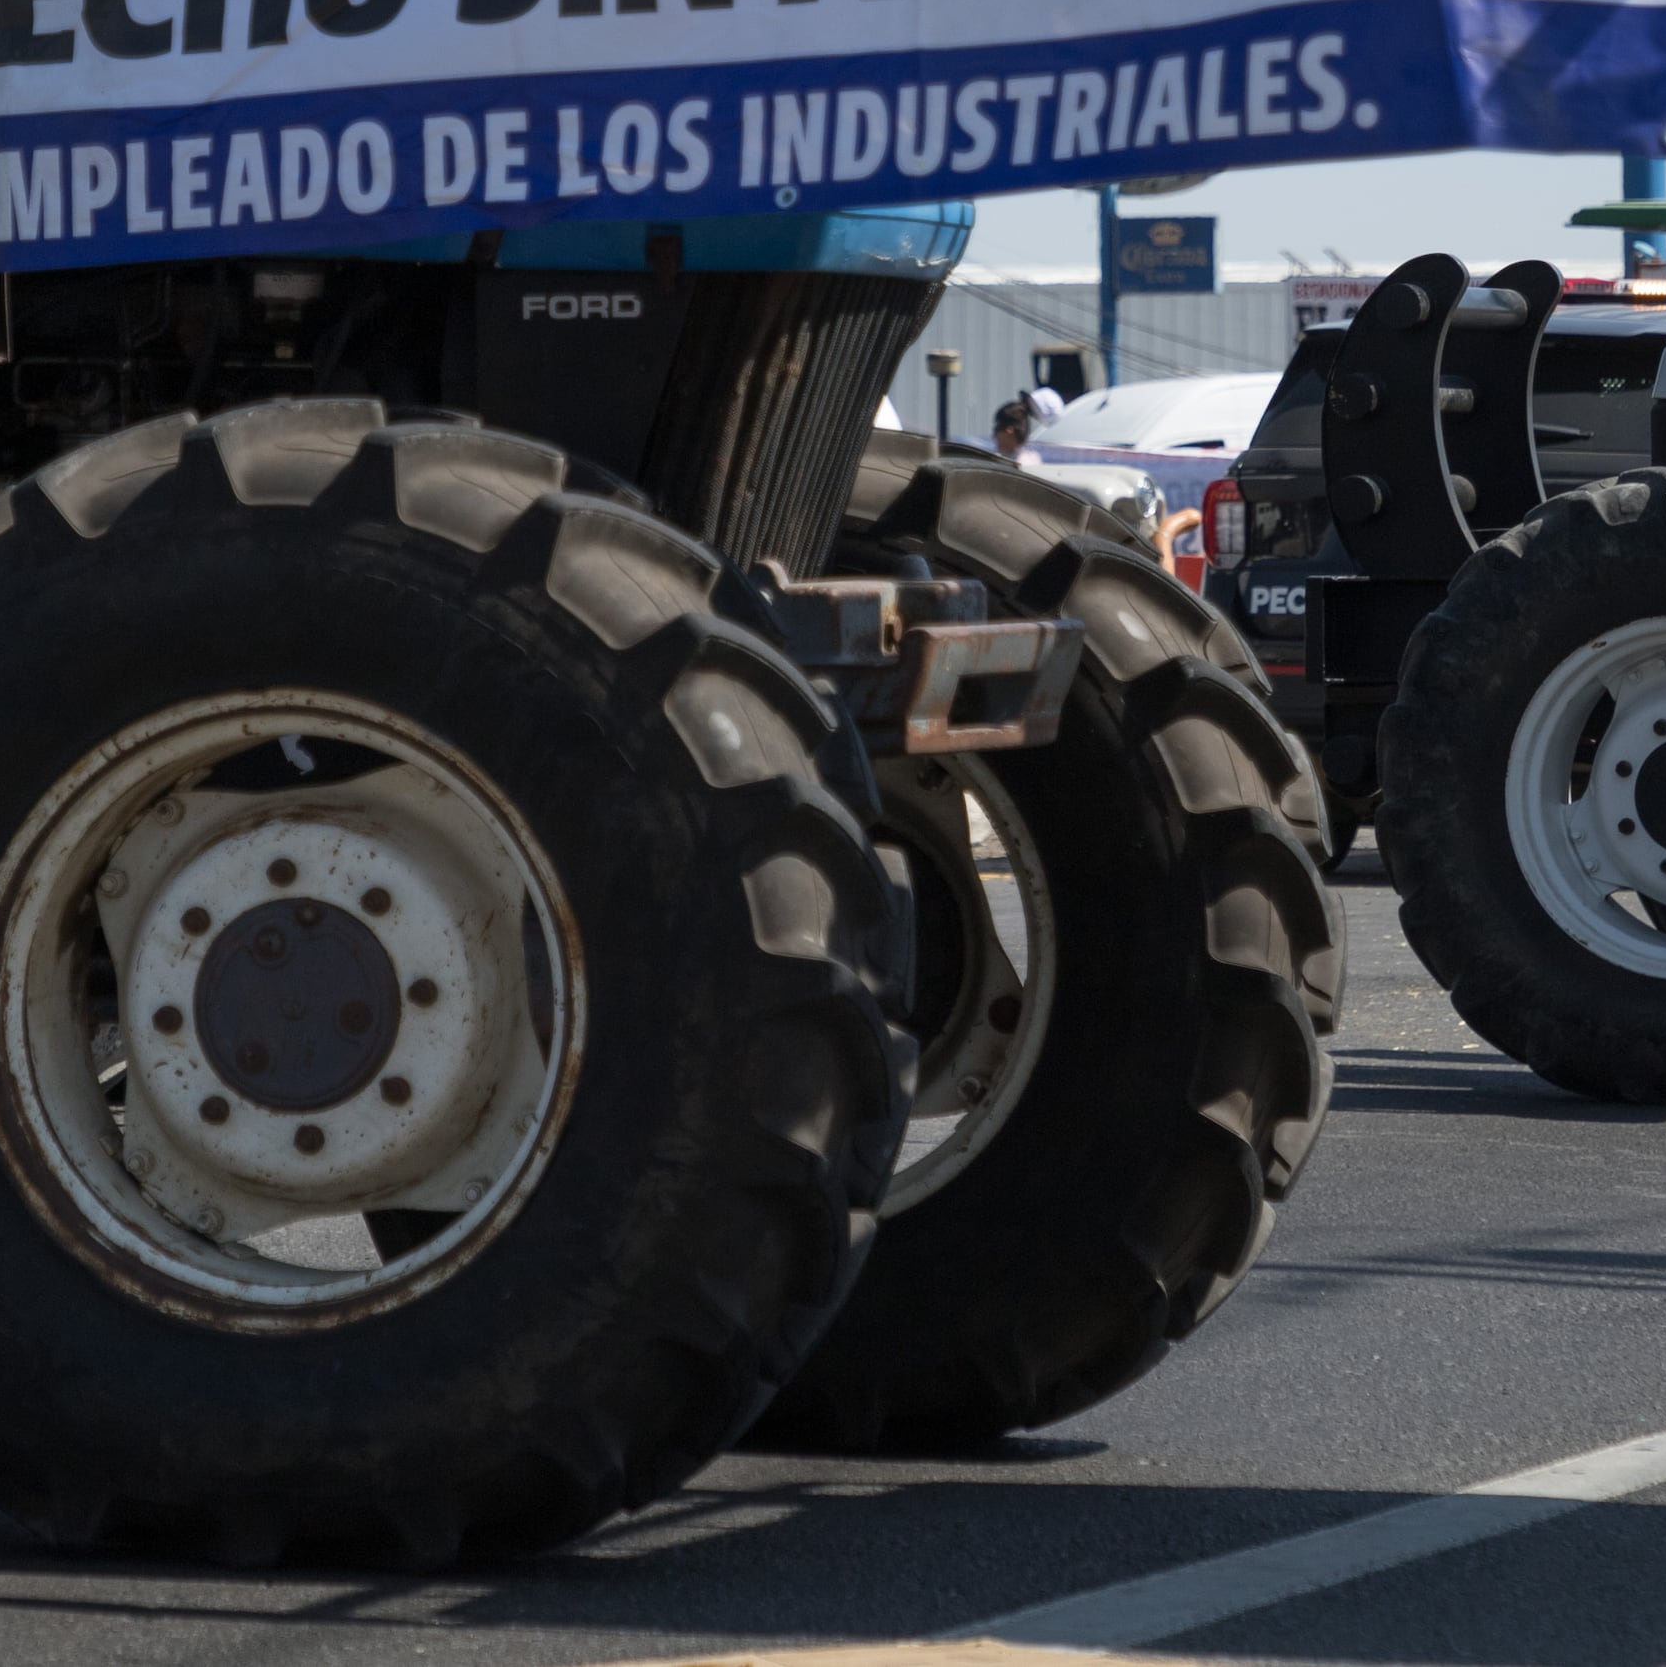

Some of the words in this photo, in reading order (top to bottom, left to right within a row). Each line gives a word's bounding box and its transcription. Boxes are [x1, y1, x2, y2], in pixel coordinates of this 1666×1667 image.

[423, 109, 530, 208] DE
[556, 98, 713, 198] LOS
[739, 32, 1380, 190] INDUSTRIALES.
[522, 295, 642, 320] FORD
